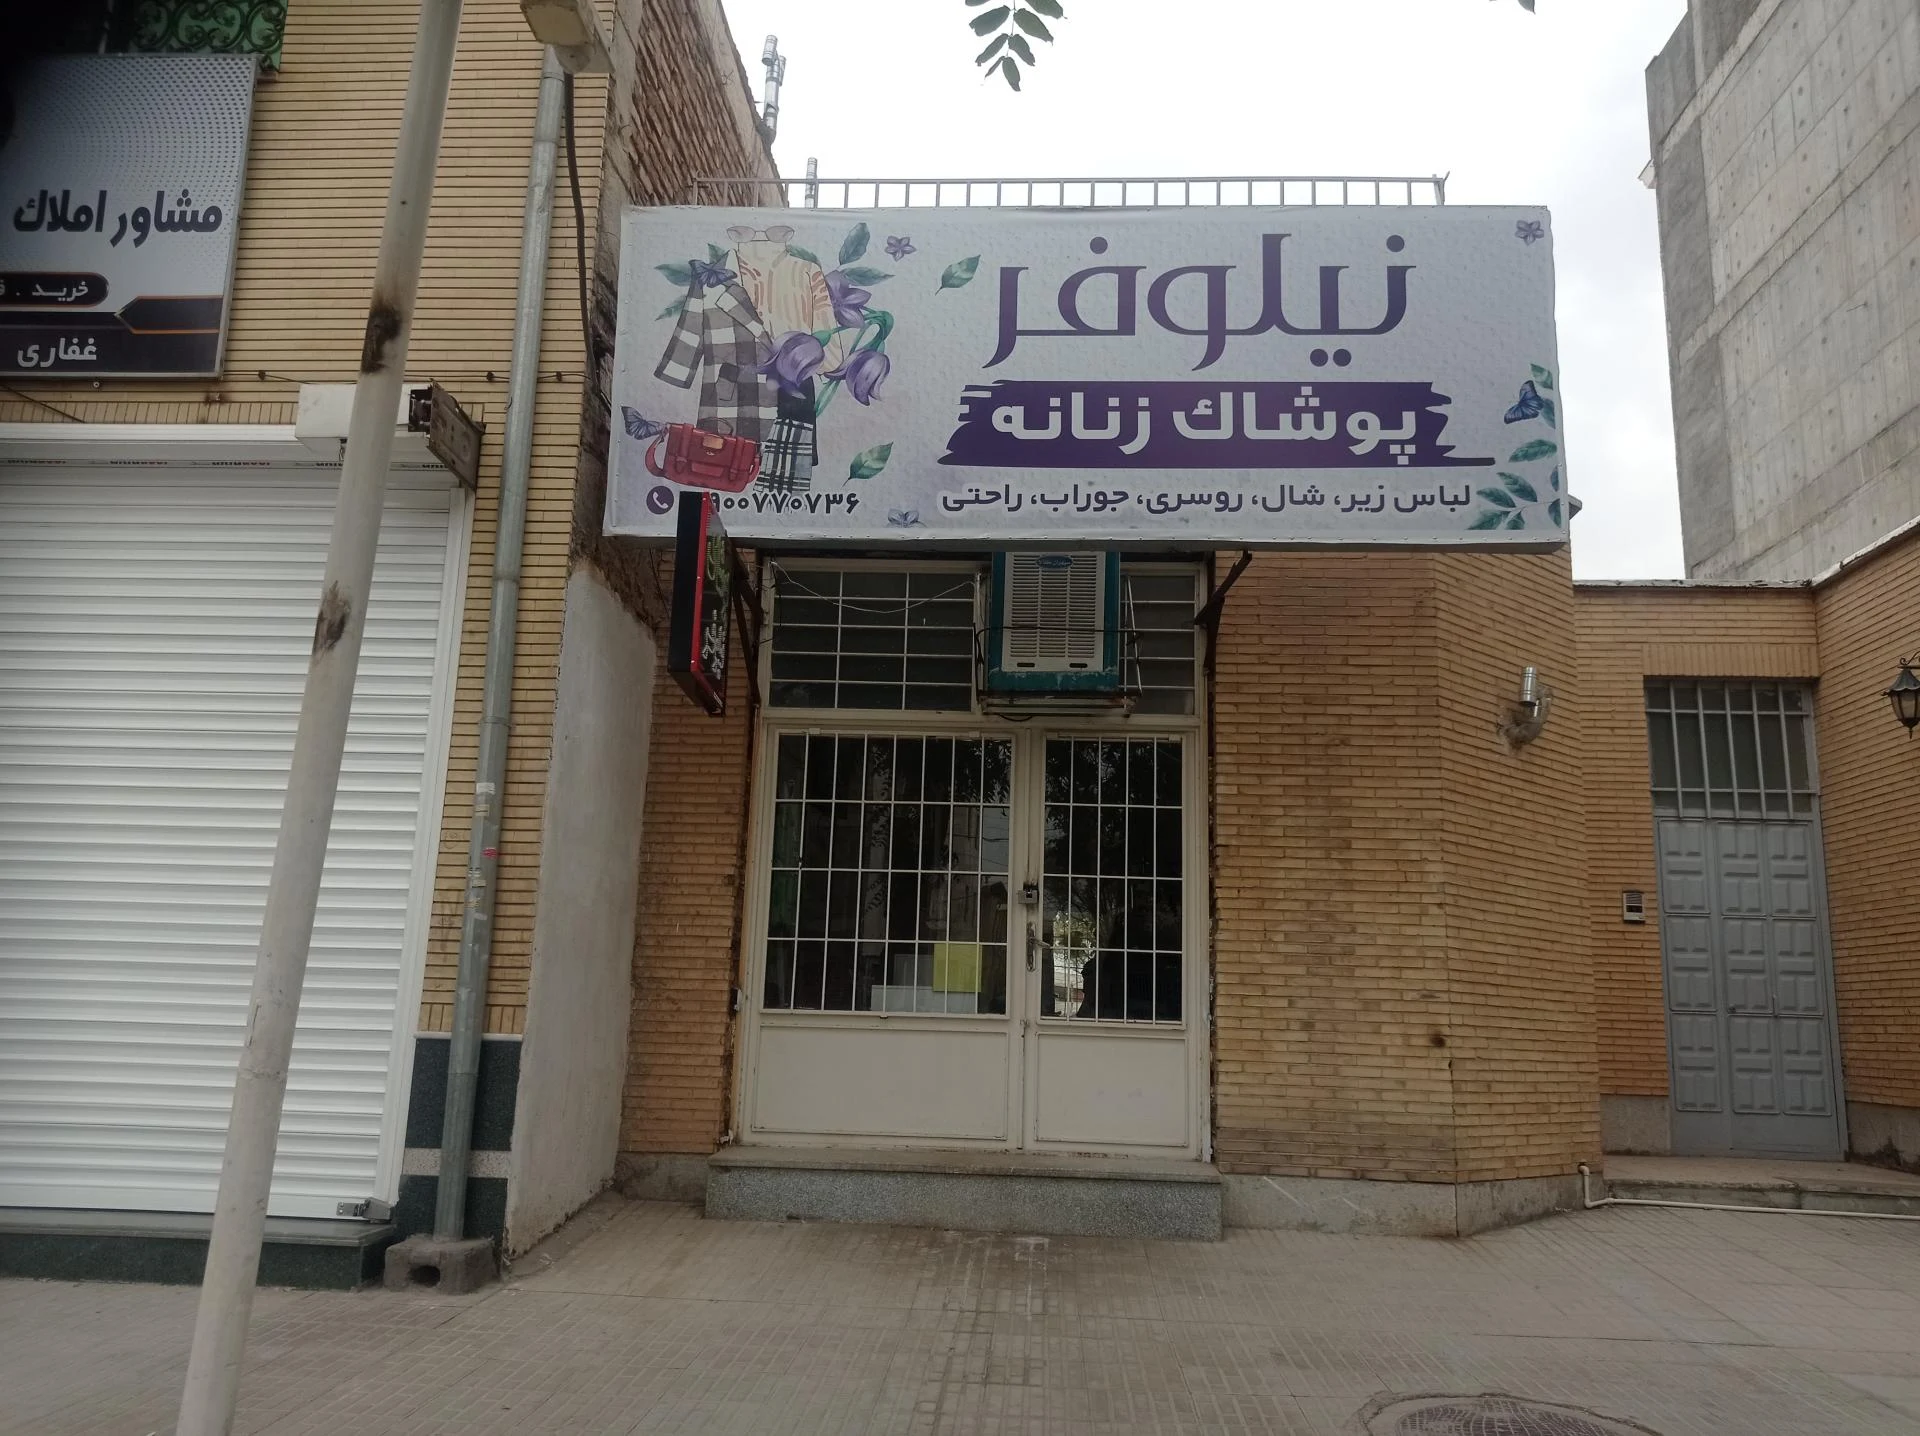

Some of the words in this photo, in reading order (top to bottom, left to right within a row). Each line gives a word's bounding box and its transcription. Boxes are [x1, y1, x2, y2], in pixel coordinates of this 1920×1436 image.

[110, 188, 223, 248] مشاور
[31, 281, 89, 302] خرید
[982, 233, 1417, 371] نیلوفر
[17, 337, 97, 368] غفاری
[991, 391, 1151, 455] زنانه
[942, 484, 1023, 512] راحتی
[1030, 484, 1130, 513] جوراب،
[1136, 489, 1243, 515] روسری،
[1251, 484, 1325, 513] شال،
[1334, 484, 1386, 513] زیر،
[1394, 484, 1471, 513] لباس
